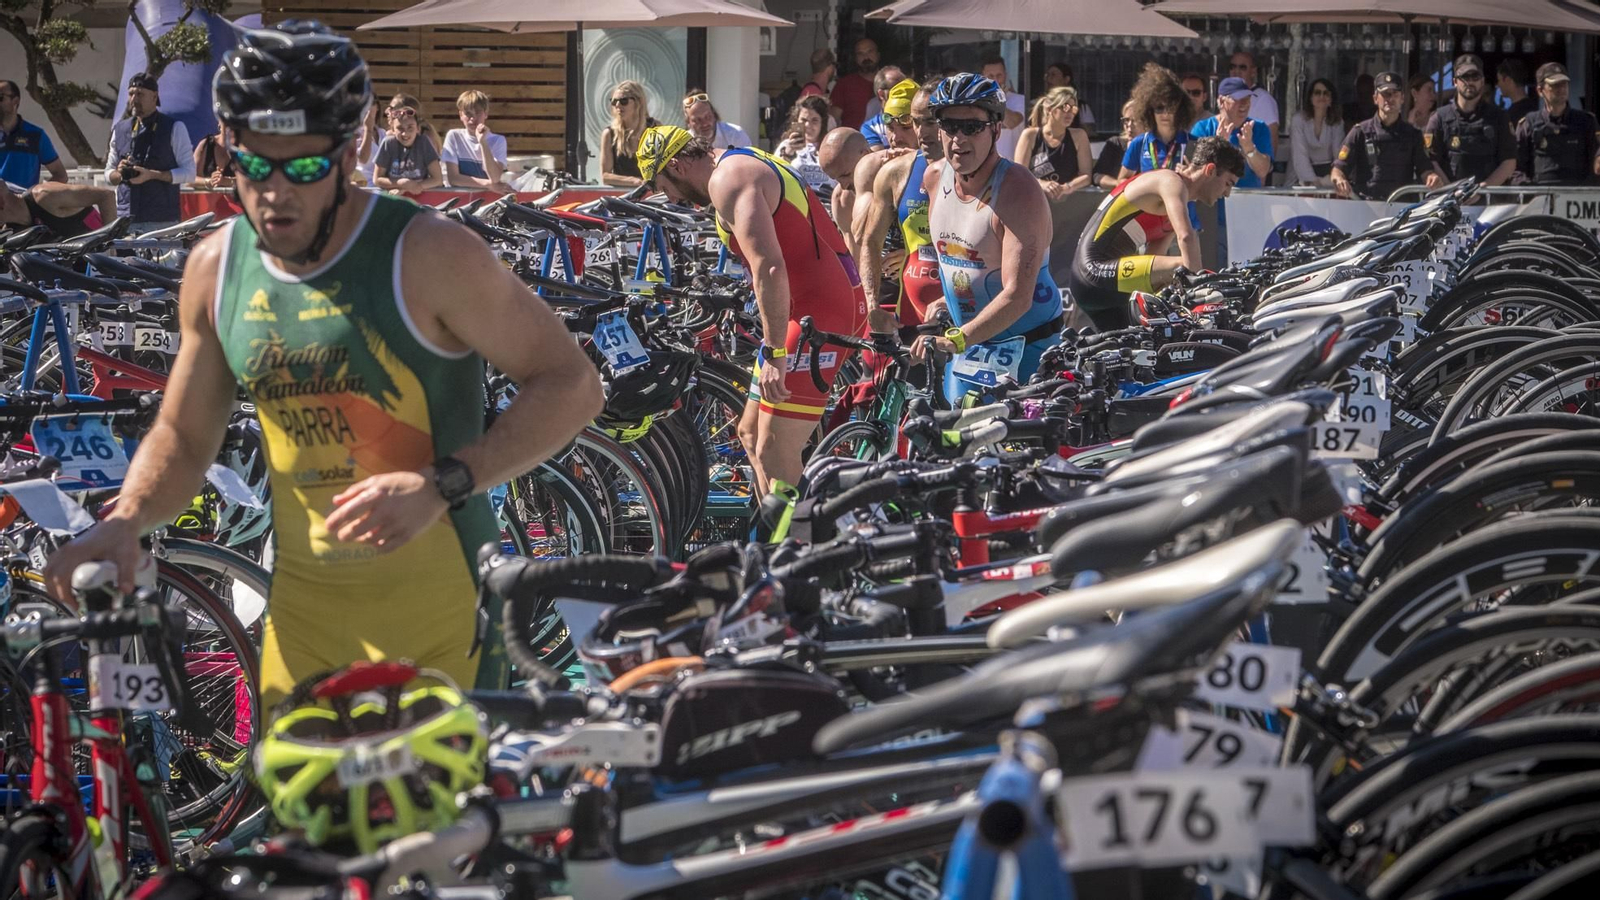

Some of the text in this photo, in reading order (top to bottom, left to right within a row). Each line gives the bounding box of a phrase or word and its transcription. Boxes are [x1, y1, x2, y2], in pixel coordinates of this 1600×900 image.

[529, 255, 542, 267] 66
[1399, 293, 1418, 306] 07
[140, 331, 171, 351] 254
[601, 324, 630, 351] 257
[965, 344, 1015, 367] 275
[1350, 375, 1375, 396] 91
[1347, 405, 1377, 423] 90
[278, 405, 357, 449] PARRA
[46, 435, 114, 462] 246
[1207, 654, 1267, 692] 80
[112, 671, 164, 704] 193
[1094, 787, 1220, 849] 176
